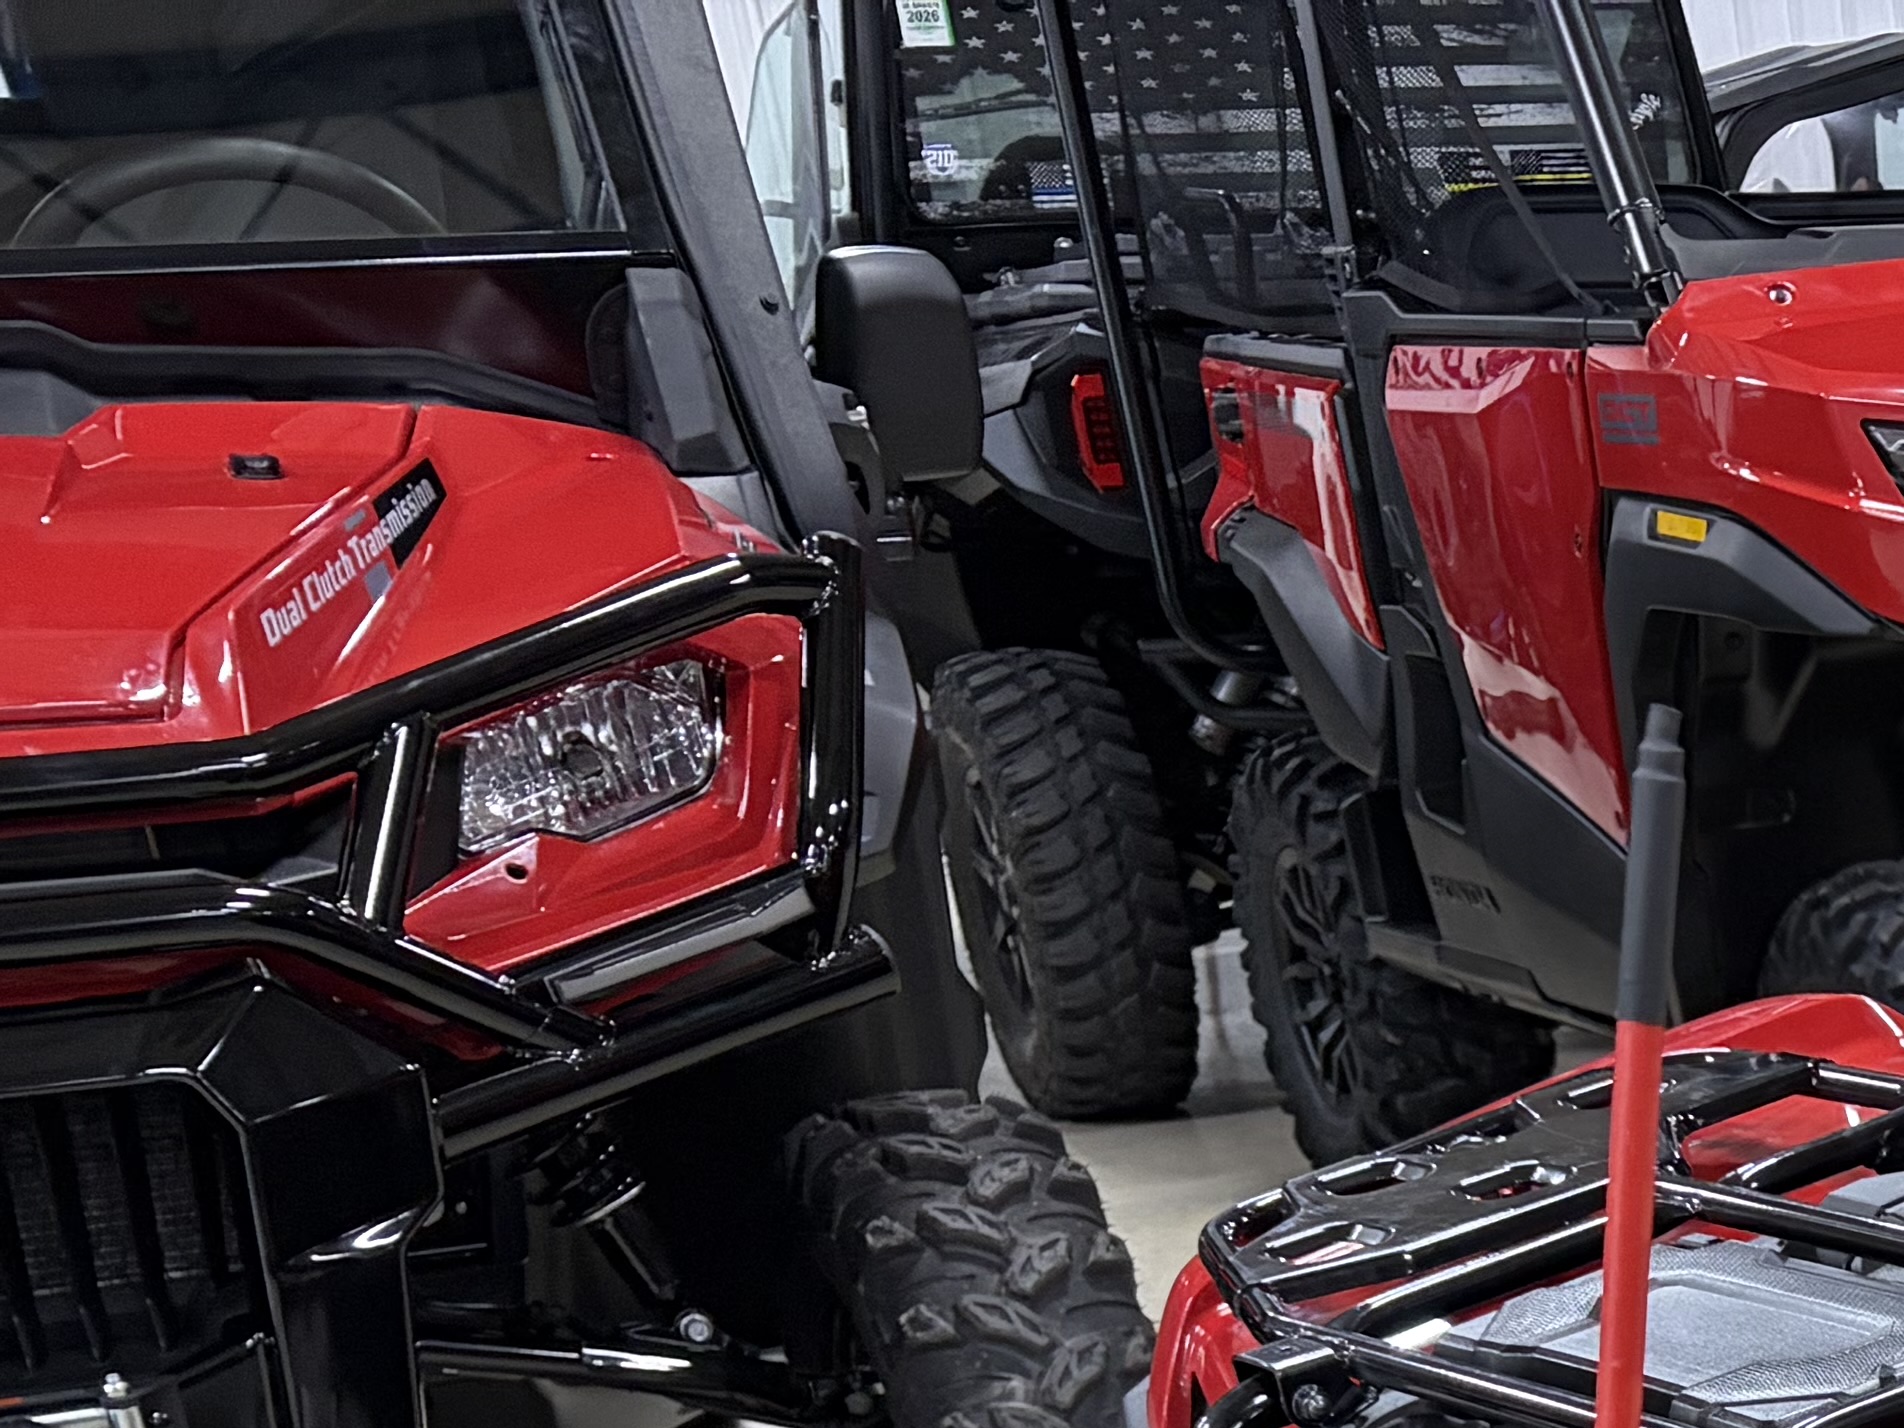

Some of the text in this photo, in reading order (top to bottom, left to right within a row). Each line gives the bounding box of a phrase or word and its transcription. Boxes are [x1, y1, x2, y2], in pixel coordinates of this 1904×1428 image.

[260, 477, 437, 647] Dual Clutch Transmission
